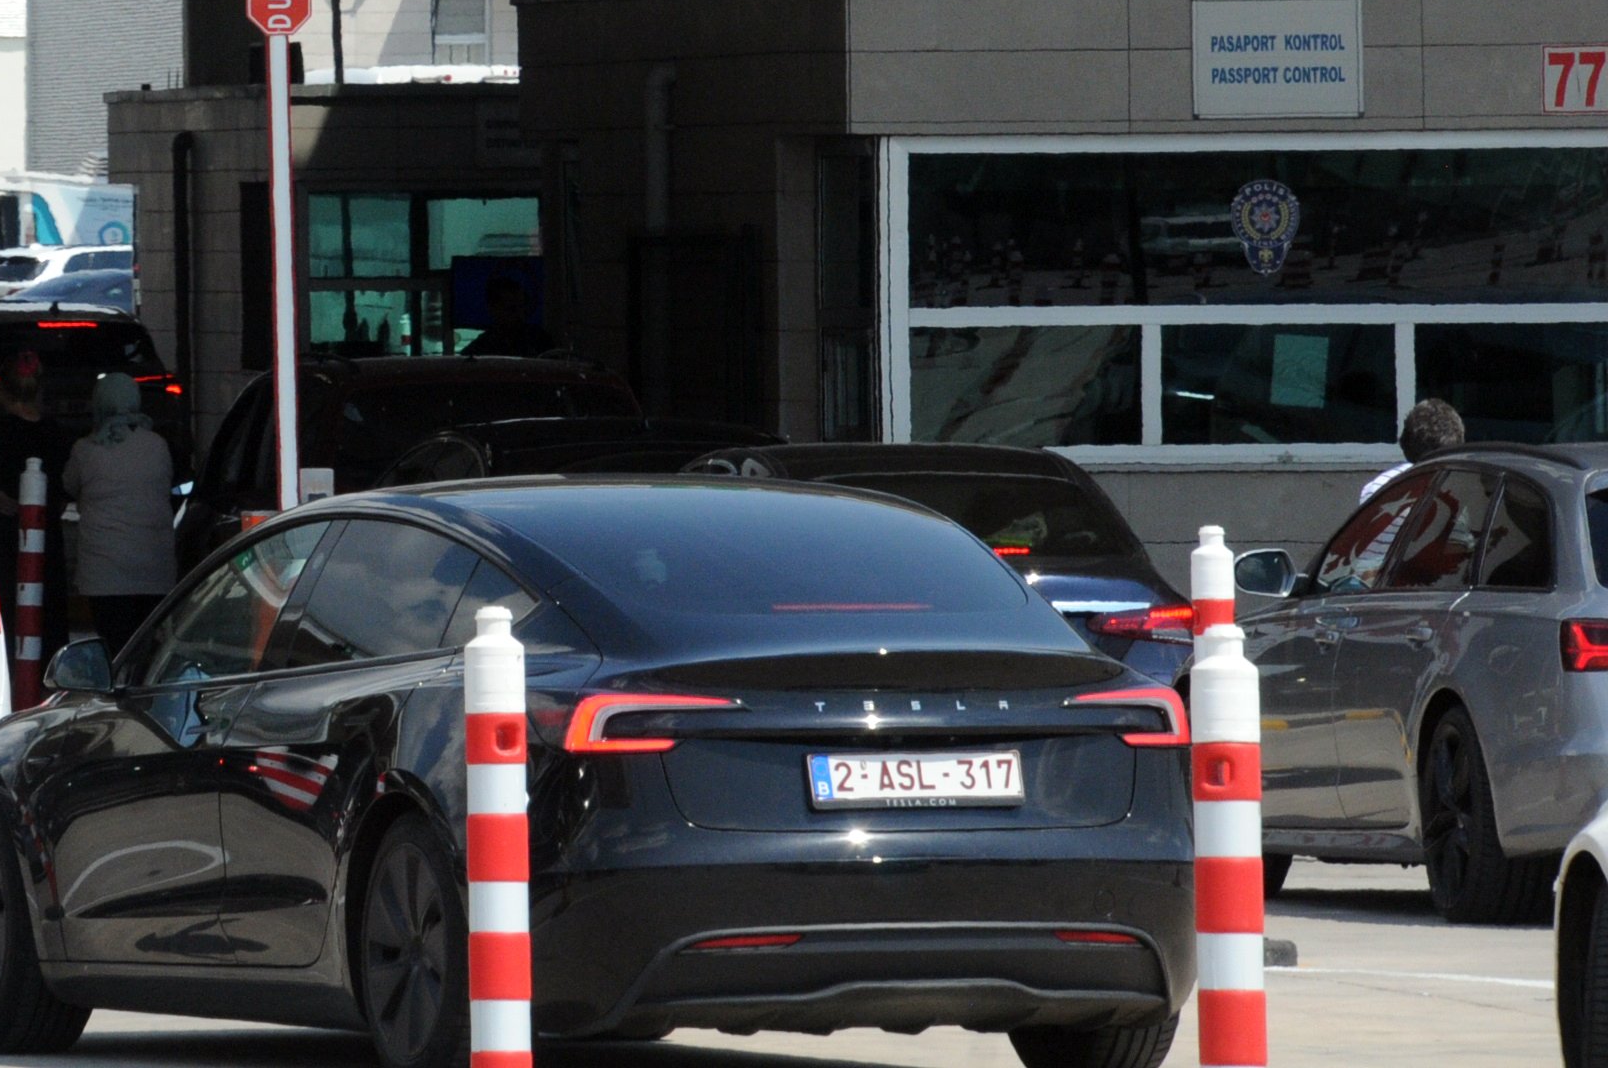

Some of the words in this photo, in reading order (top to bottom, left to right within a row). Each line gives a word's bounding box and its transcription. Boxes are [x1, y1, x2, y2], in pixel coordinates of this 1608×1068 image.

[1210, 35, 1277, 52] PASAPORT
[1284, 34, 1346, 51] KONTROL
[1211, 66, 1279, 84] PASSPORT
[1283, 66, 1346, 84] CONTROL
[1548, 52, 1607, 107] 77
[815, 700, 1009, 712] TESLA
[834, 759, 1014, 792] 2-ASL-317
[817, 781, 830, 795] B
[885, 798, 957, 807] TESLA.COM
